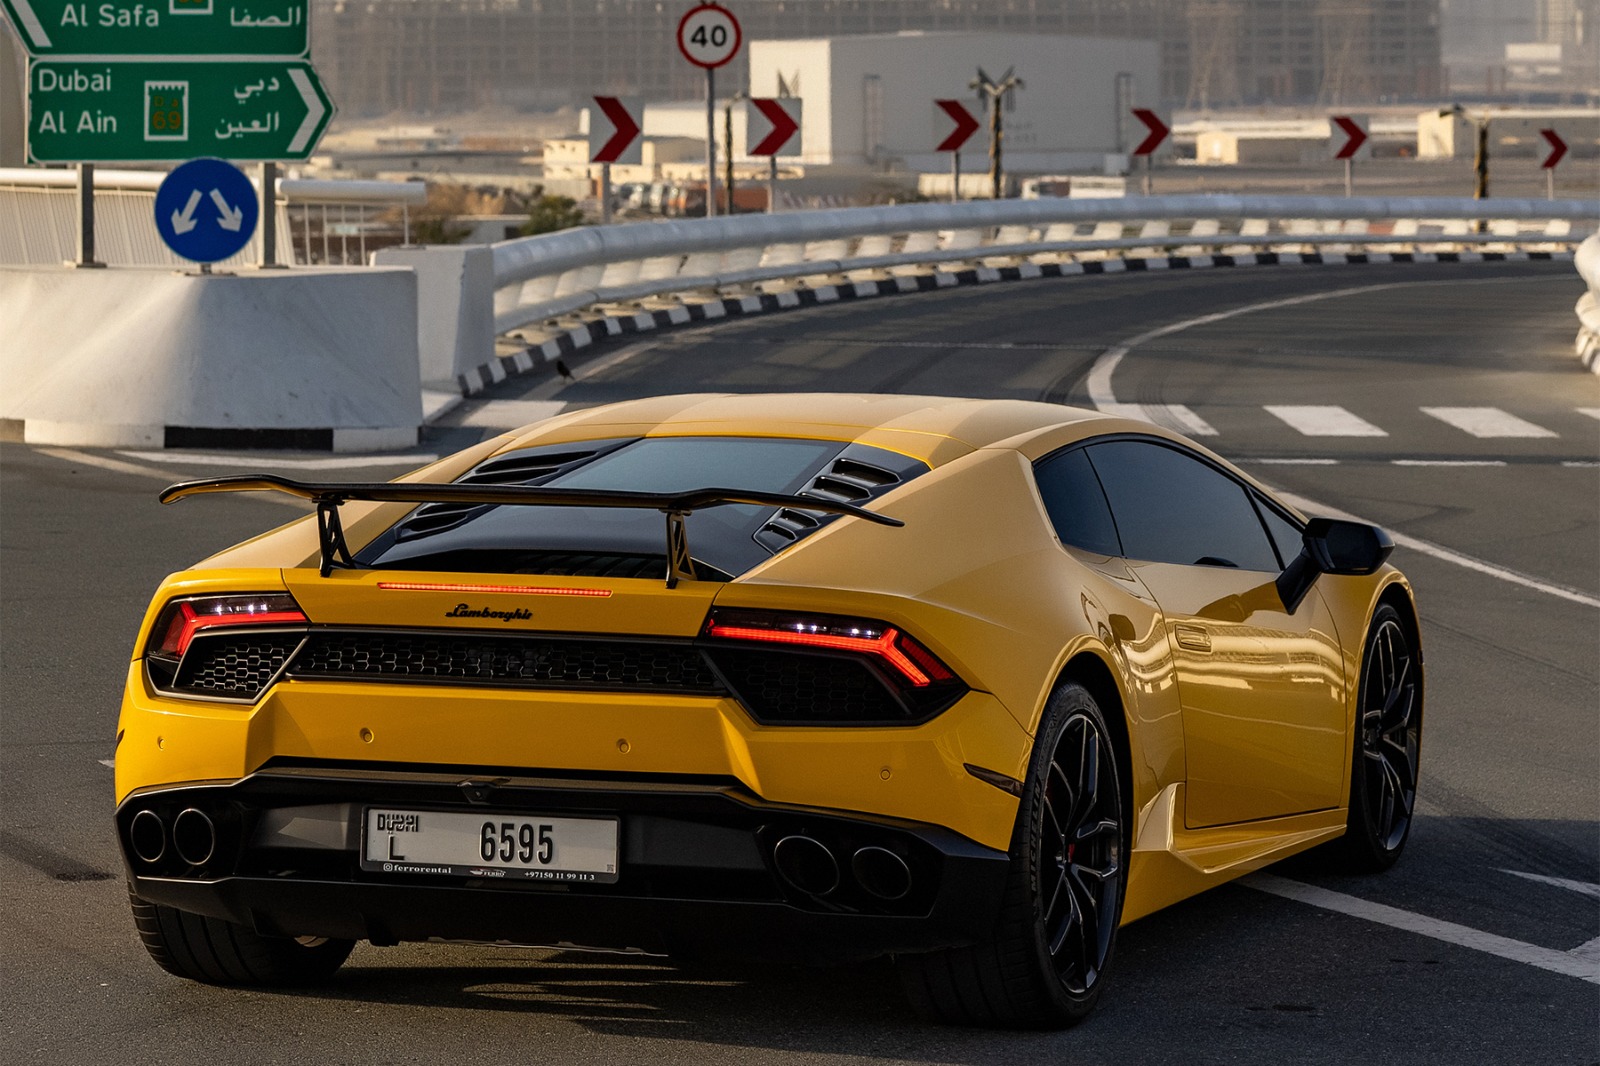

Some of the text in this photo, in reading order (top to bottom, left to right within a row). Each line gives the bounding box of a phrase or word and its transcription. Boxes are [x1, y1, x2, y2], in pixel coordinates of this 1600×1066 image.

[60, 5, 159, 27] Al Safa
[230, 6, 301, 27] الصفا
[691, 25, 727, 47] 40
[38, 69, 112, 92] Dubai
[234, 76, 280, 104] دبي
[38, 111, 118, 134] Al Ain
[152, 110, 182, 130] 69
[214, 112, 280, 139] العين
[389, 836, 405, 861] L
[480, 822, 554, 865] 6595
[1030, 782, 1040, 892] MICHELIN
[394, 864, 452, 874] ferrorental
[524, 871, 553, 879] +97150
